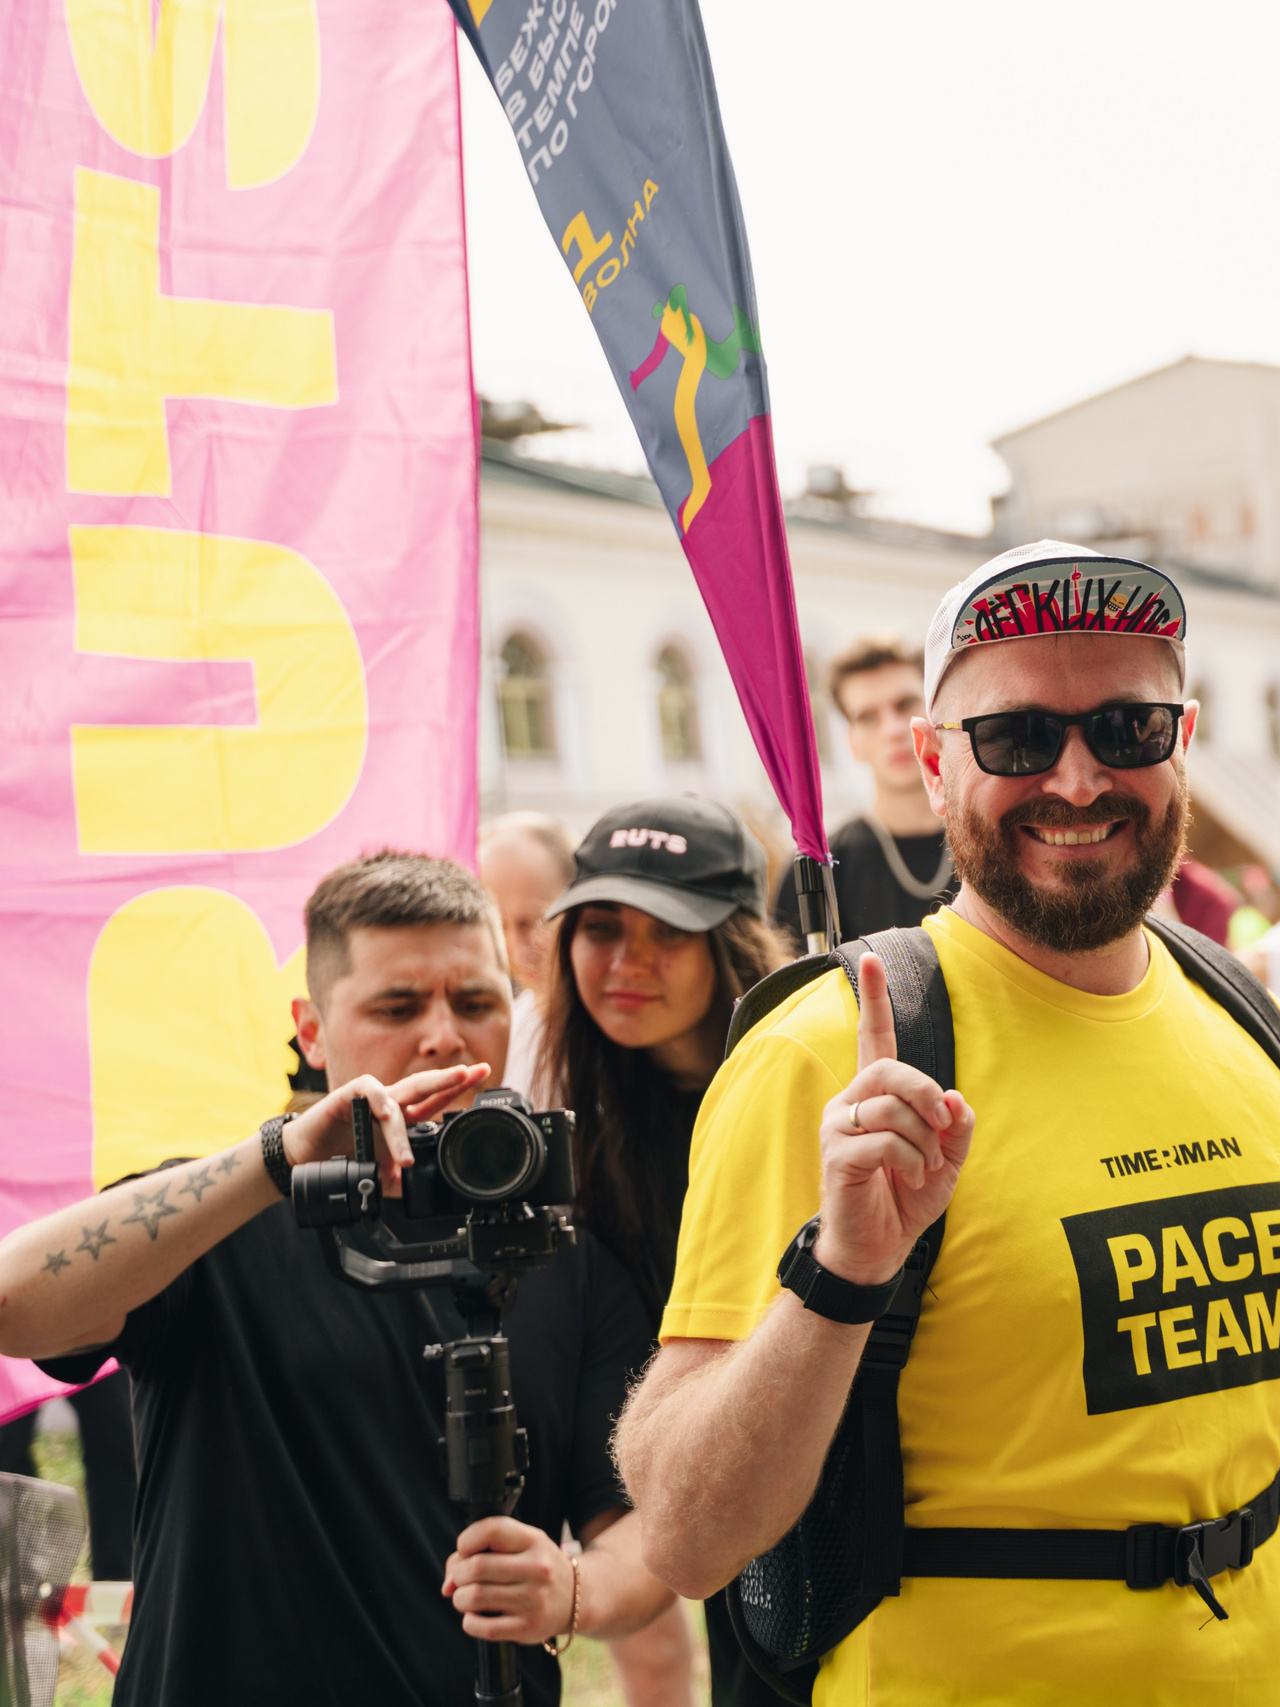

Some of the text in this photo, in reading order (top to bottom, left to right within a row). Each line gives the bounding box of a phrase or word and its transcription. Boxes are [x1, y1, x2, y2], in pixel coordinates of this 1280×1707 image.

[494, 0, 546, 98] БЕЖ
[516, 0, 585, 150] ТЕМПЕ
[527, 0, 617, 185] ПО ГОРО
[504, 89, 527, 126] В
[562, 210, 613, 284] 1
[582, 178, 659, 315] ВОЛНА
[480, 1096, 513, 1106] SONY
